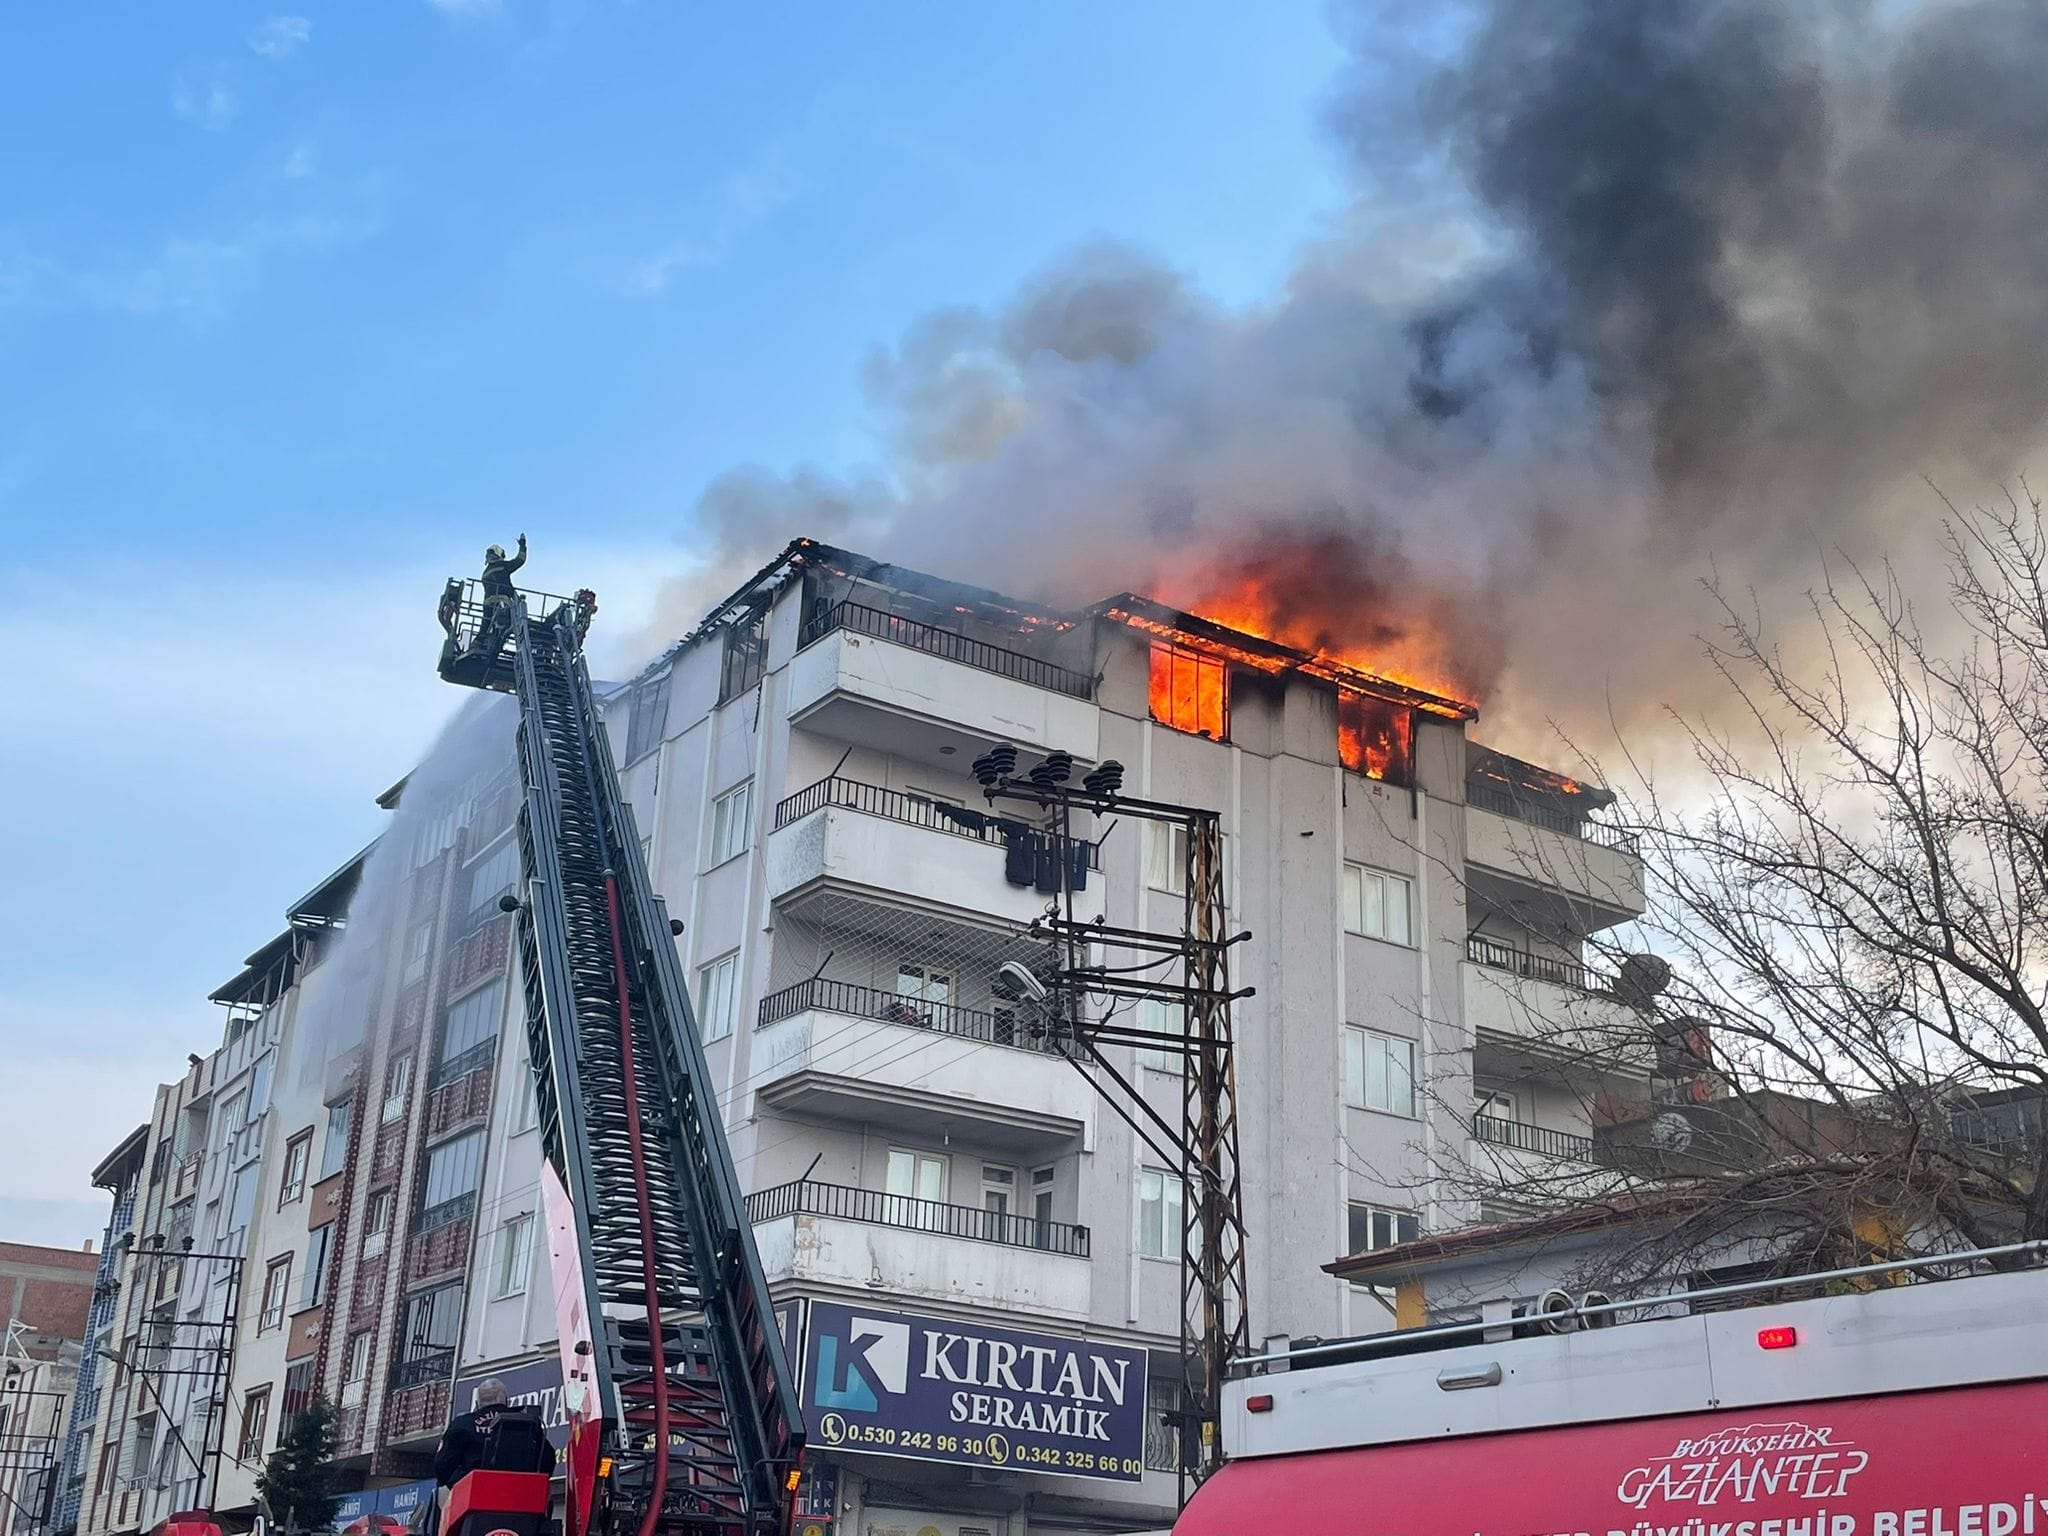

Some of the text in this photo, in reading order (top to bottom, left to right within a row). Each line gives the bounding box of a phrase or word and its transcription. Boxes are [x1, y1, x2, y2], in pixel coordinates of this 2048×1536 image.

[920, 1330, 1130, 1405] KIRTAN
[848, 1424, 982, 1455] 0.530 242 96 30
[950, 1391, 1111, 1441] SERAMİK
[1015, 1445, 1141, 1475] 0.342 325 66 00
[1617, 1451, 1869, 1509] GAZİANTEP
